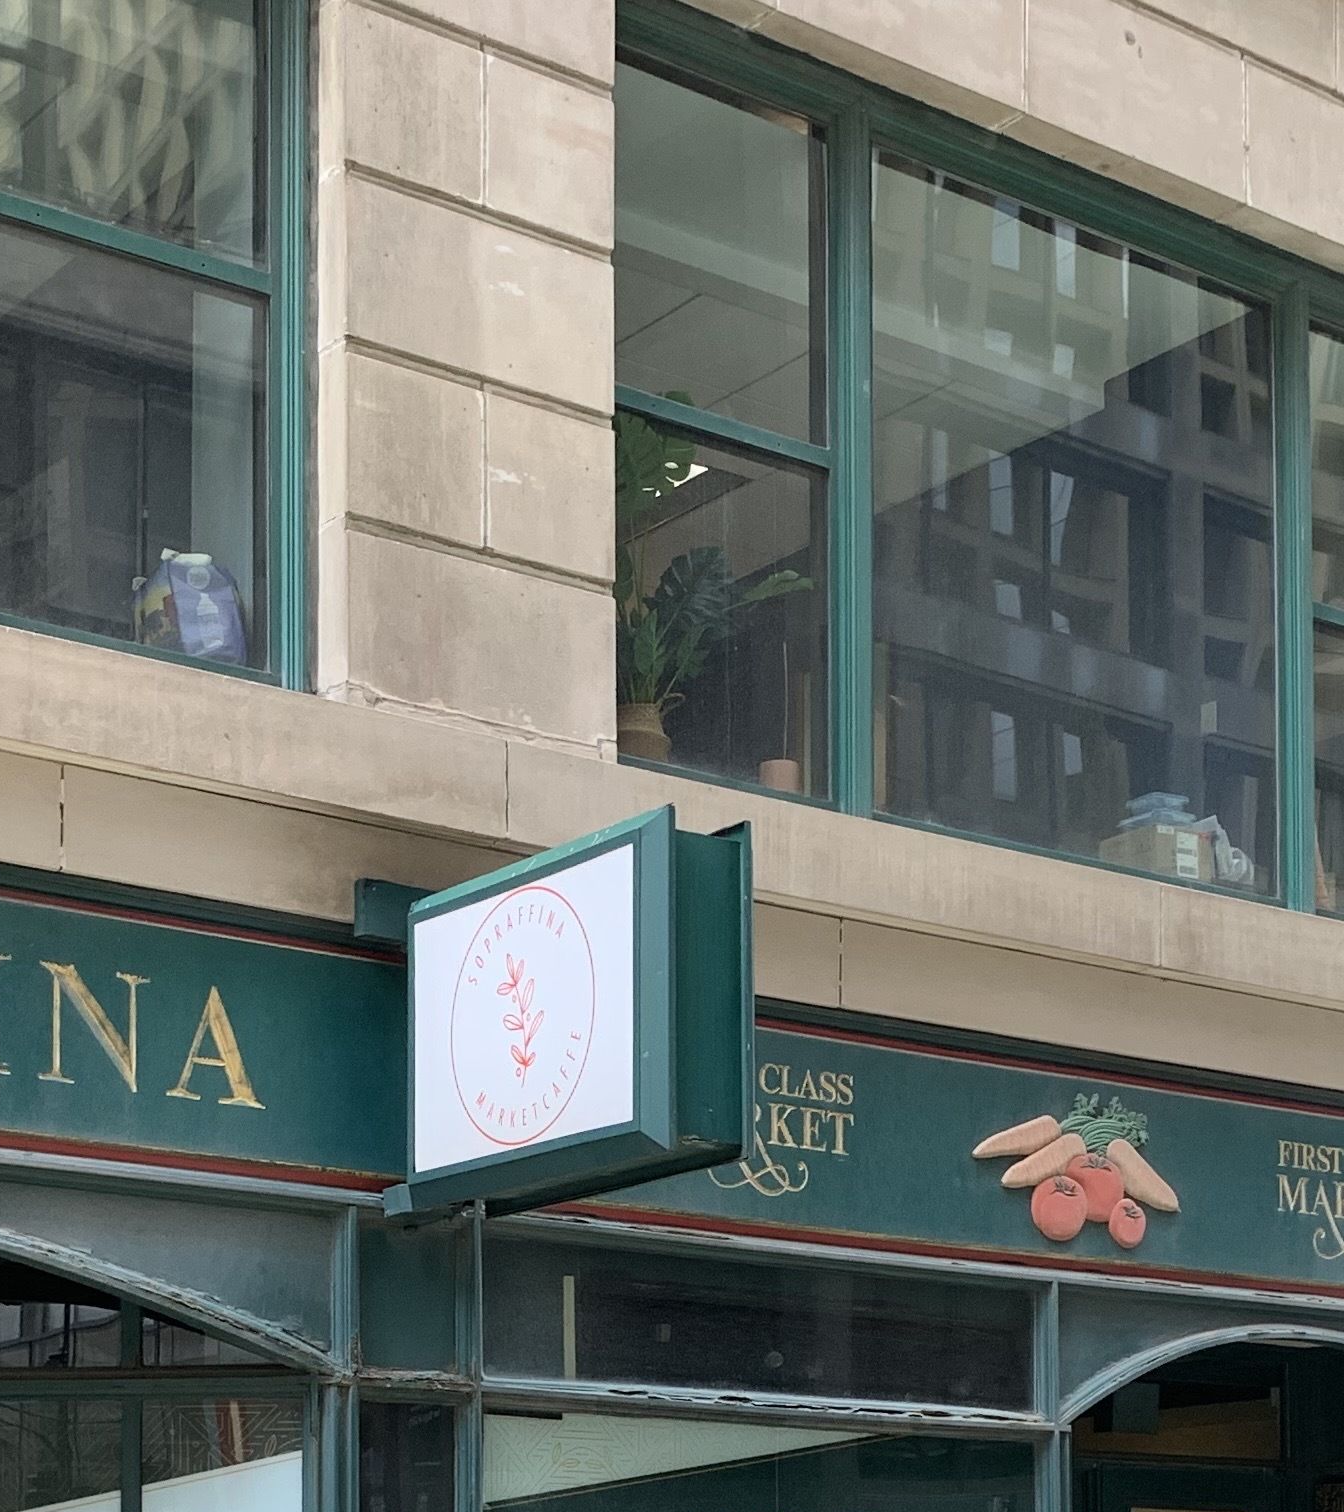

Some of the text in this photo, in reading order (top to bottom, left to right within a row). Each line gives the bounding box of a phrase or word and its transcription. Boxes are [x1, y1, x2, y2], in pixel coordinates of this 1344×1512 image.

[468, 903, 565, 986] SOPRAFFINA
[759, 1063, 854, 1105] CLASS
[1277, 1139, 1344, 1175] FIRST
